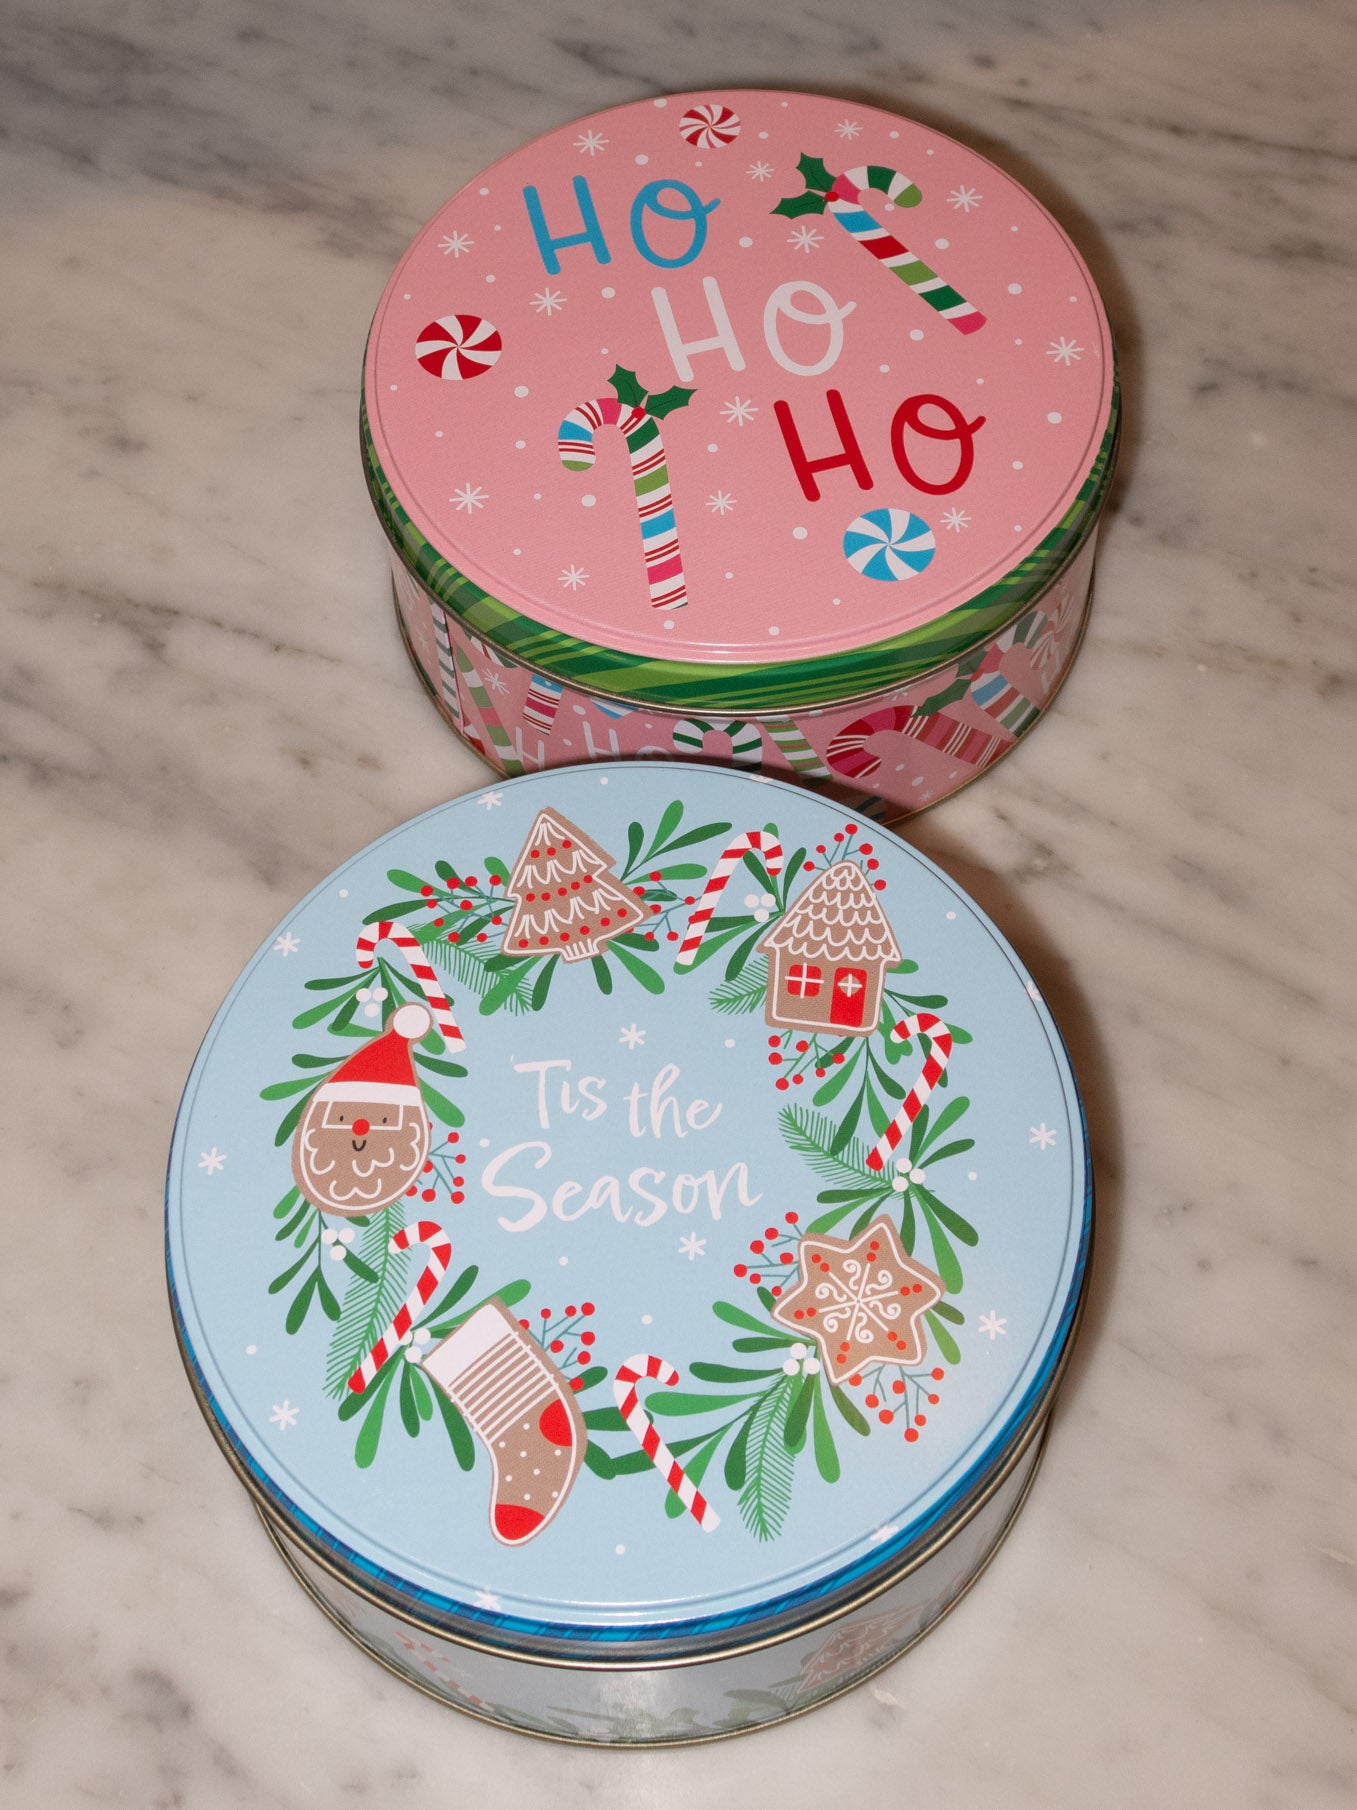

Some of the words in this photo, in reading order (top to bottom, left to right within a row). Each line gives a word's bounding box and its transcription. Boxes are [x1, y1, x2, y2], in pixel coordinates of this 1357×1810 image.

[523, 176, 721, 275] HO
[651, 276, 857, 382] HO
[773, 389, 986, 502] HO
[623, 1063, 723, 1138] the
[481, 1140, 763, 1232] Season
